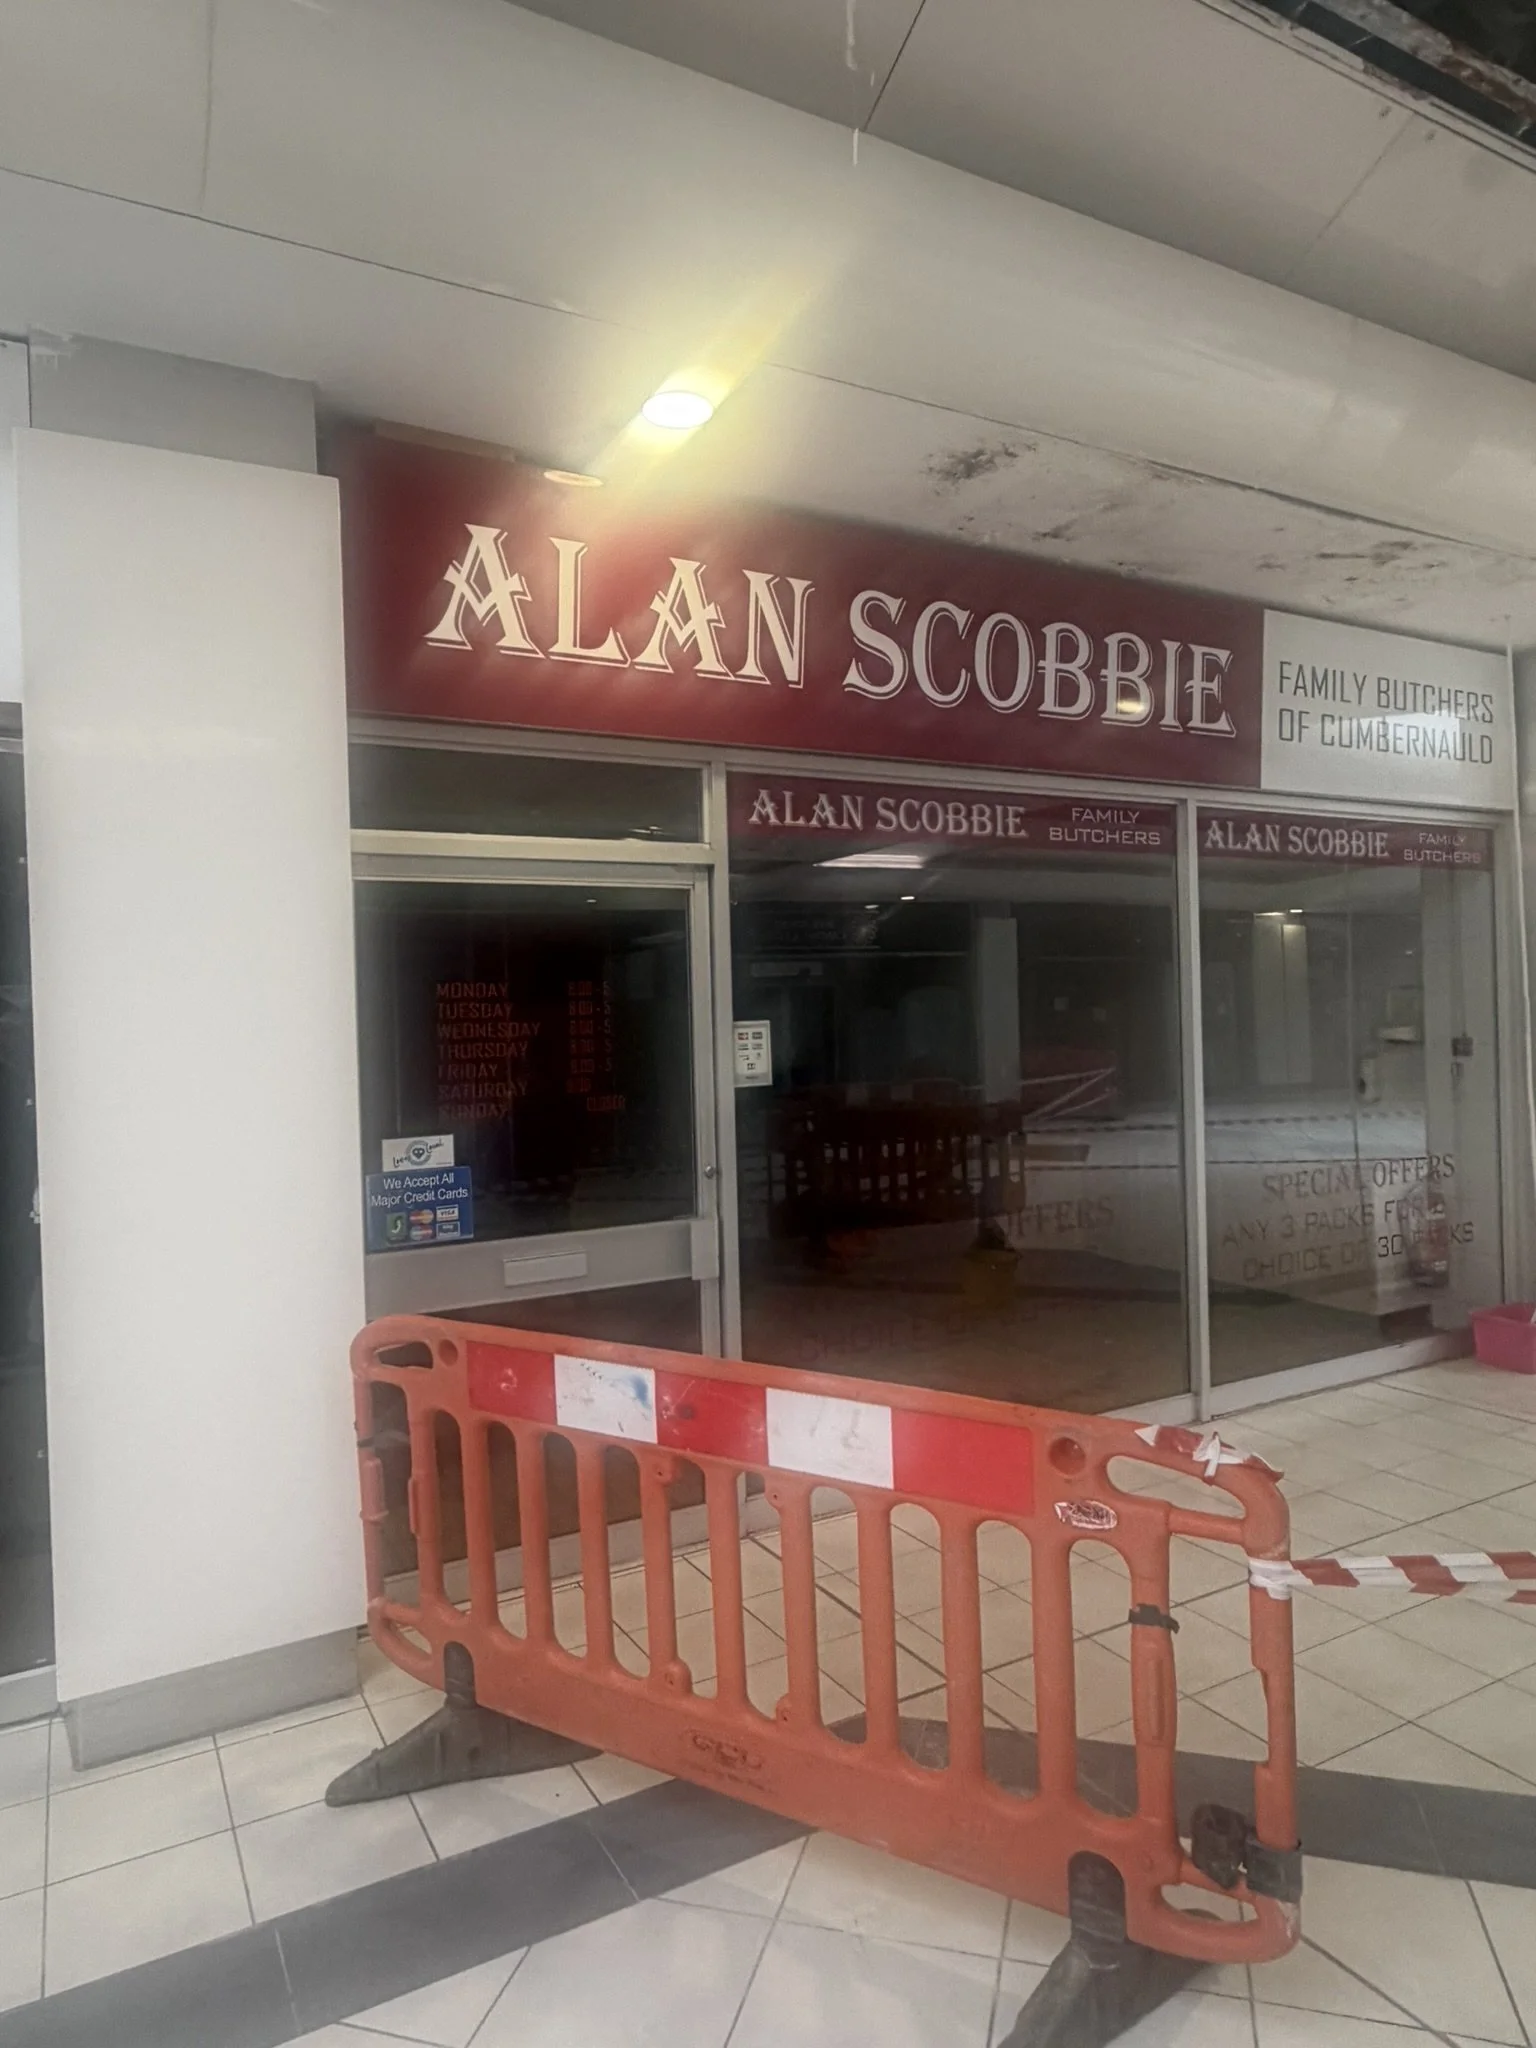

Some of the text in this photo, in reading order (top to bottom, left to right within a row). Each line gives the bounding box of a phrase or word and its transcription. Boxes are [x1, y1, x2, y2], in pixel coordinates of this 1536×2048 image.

[424, 523, 1237, 737] ALAN SCOBBIE
[1279, 661, 1494, 724] FAMILY BUTCHERS
[1279, 708, 1493, 764] OF CUMBERNAULD
[748, 789, 1030, 837] ALAN SCOBBIE
[1072, 807, 1141, 824] FAMILY
[1049, 827, 1161, 846] BUTCHERS
[1204, 820, 1390, 858] ALAN SCOBBIE
[1419, 832, 1467, 847] FAMILY
[1404, 849, 1482, 864] BUTCHERS
[436, 982, 509, 998] MONDAY
[437, 1002, 513, 1019] TUESDAY
[437, 1021, 541, 1039] WEDNESDAY
[437, 1041, 528, 1060] THURSDAY
[438, 1062, 498, 1080] FRIDAY
[438, 1080, 528, 1100] SATURDAY
[383, 1172, 455, 1190] We Accept All
[1263, 1155, 1456, 1201] SPECIAL OFFERS
[371, 1187, 469, 1208] Major Credit Cards
[1281, 1214, 1295, 1239] 3
[1304, 1203, 1374, 1234] PACKS
[1242, 1246, 1333, 1281] CHOICE
